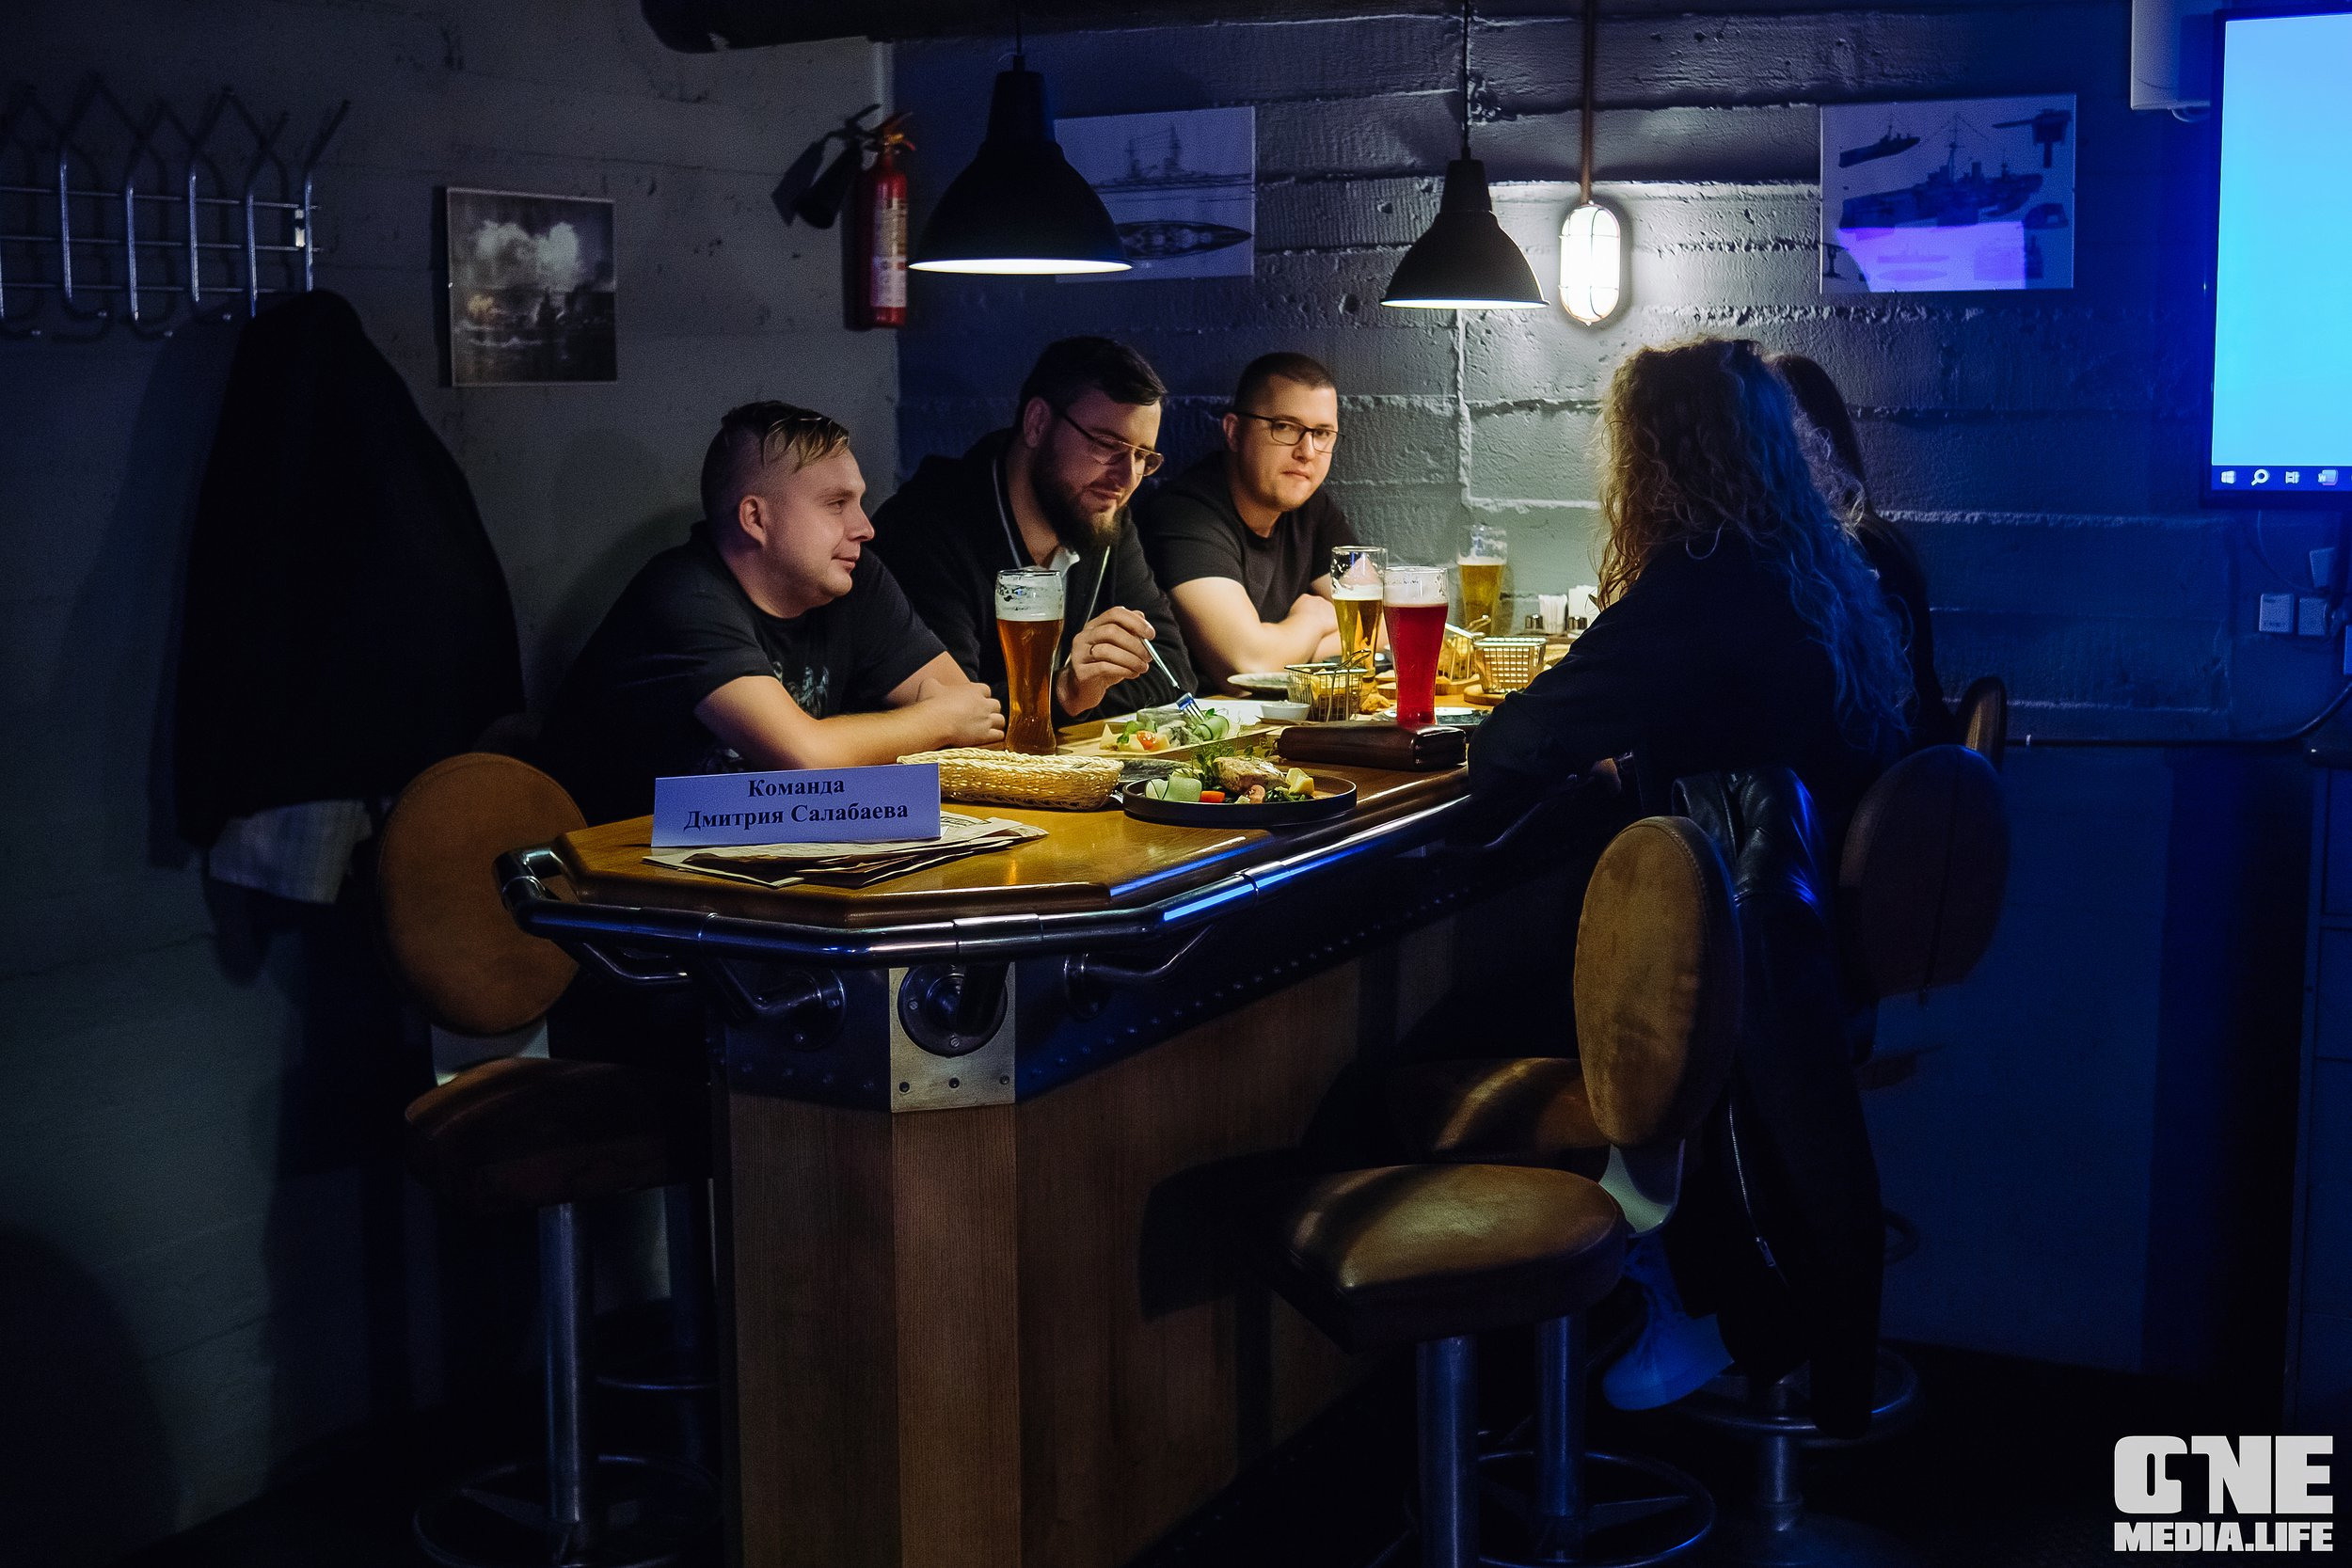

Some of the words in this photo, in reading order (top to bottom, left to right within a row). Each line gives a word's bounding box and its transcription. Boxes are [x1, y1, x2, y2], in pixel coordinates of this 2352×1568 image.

[747, 779, 846, 798] Команда
[683, 810, 784, 831] Дмитрия
[790, 802, 909, 824] Салабаева
